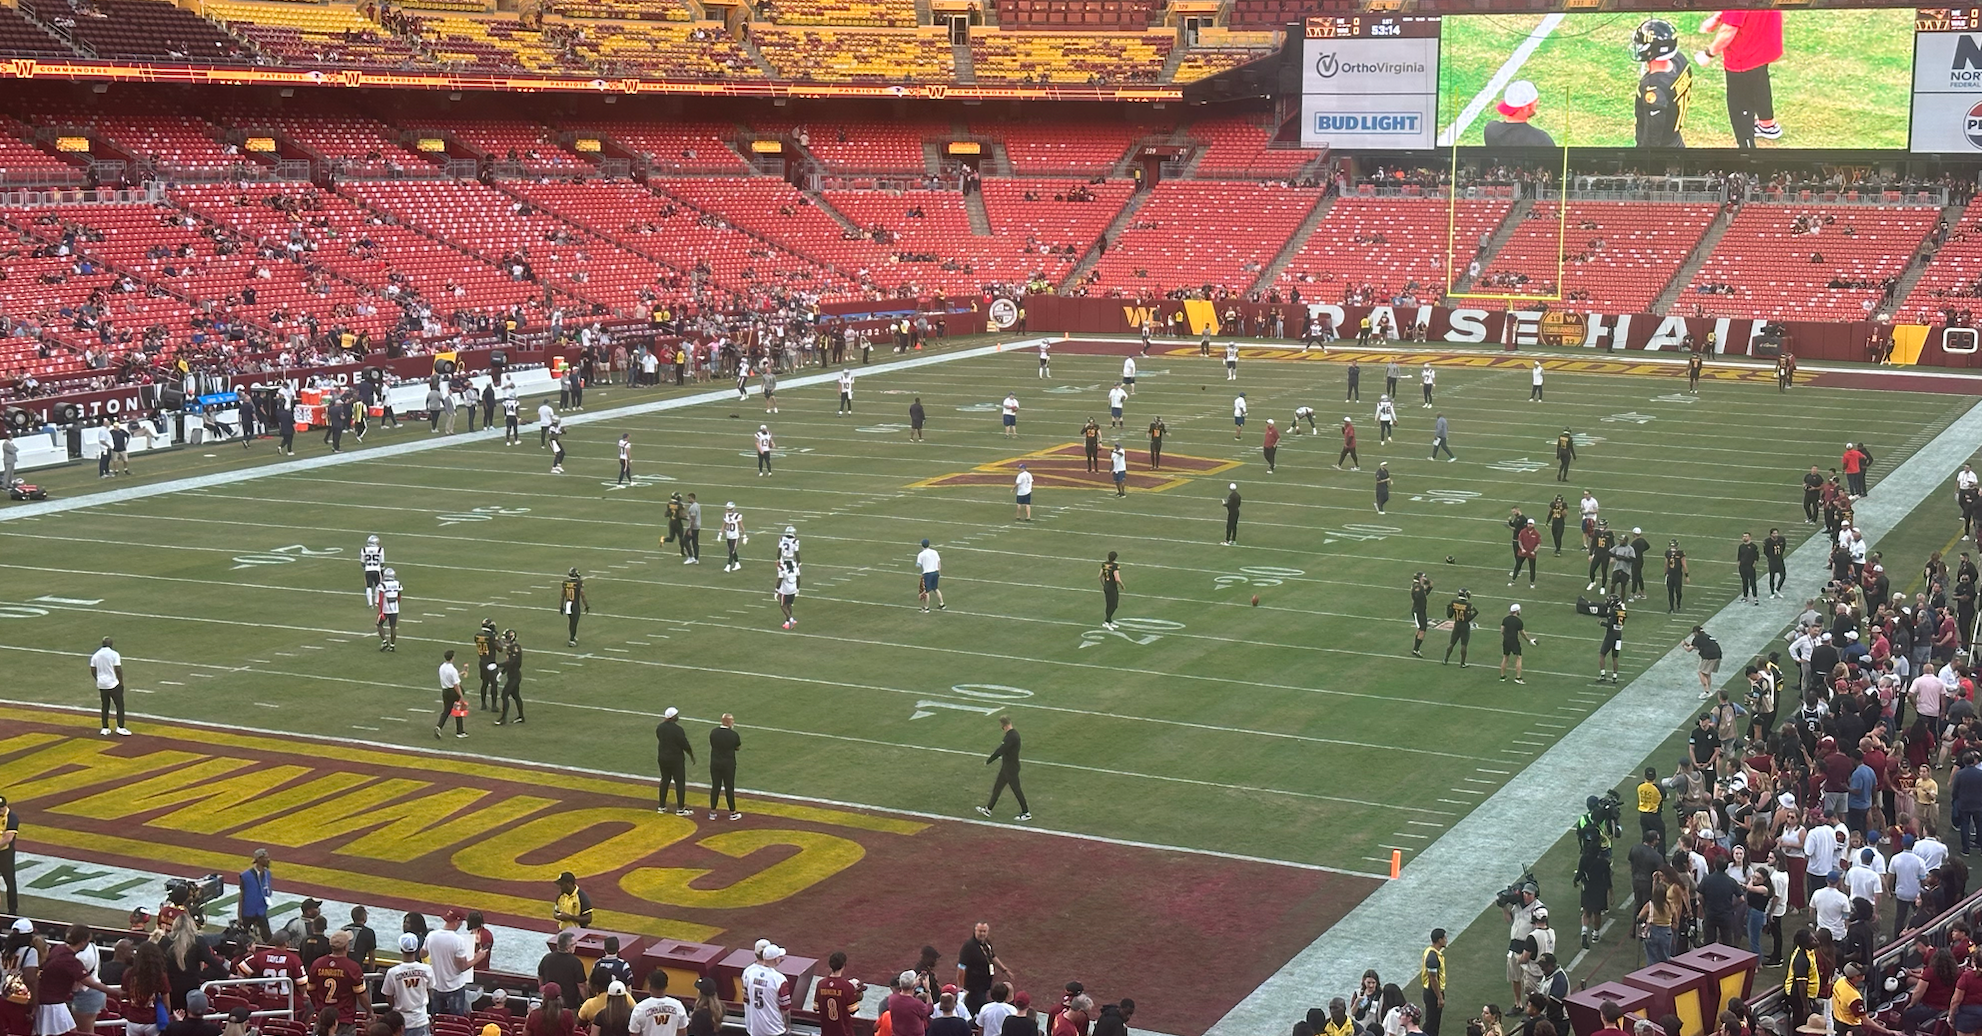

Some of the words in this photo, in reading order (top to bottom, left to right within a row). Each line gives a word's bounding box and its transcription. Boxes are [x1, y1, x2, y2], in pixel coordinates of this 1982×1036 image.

[1371, 25, 1401, 35] 53:14
[40, 66, 107, 74] COMMANDERS
[1341, 62, 1425, 75] OrthoVirginia
[260, 73, 303, 81] PATRIOTS
[365, 76, 422, 84] COMMANDERS
[1318, 115, 1359, 130] BUD
[1361, 115, 1419, 130] LIGHT
[232, 544, 343, 565] 20
[365, 554, 380, 566] 25
[1214, 566, 1305, 587] 30
[565, 587, 575, 601] 10
[1455, 609, 1465, 622] 14
[1080, 617, 1186, 646] 20
[914, 683, 1035, 716] 10
[1808, 722, 1815, 732] 8
[266, 954, 287, 964] TAYLOR
[263, 968, 289, 995] 21
[323, 977, 338, 1004] 2
[754, 988, 764, 1010] 5
[646, 1005, 677, 1017] COMMANDERS
[826, 997, 839, 1022] 8
